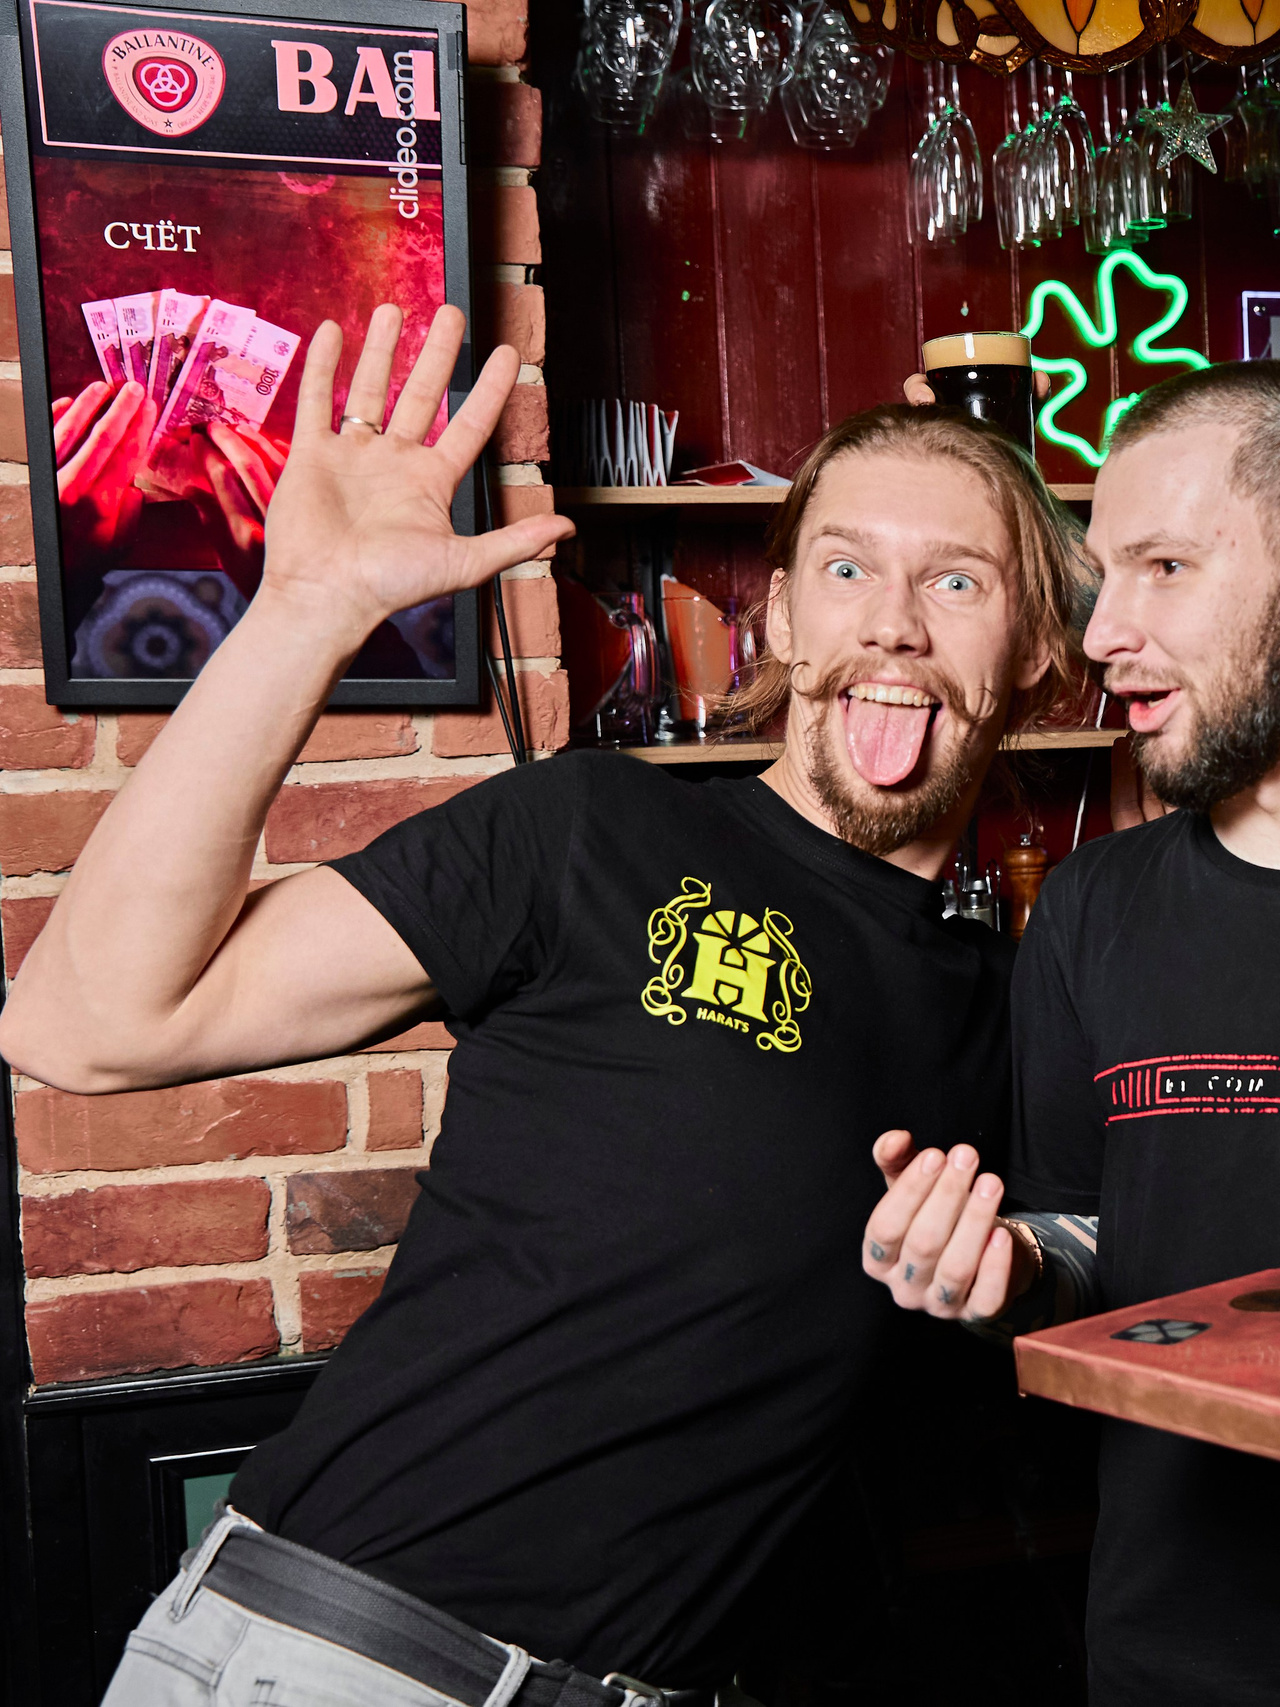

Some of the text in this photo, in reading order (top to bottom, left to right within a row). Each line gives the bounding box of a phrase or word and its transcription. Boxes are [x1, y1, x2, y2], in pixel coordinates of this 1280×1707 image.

[112, 34, 214, 67] BALLANTINE
[388, 51, 420, 219] clideo.com
[104, 220, 200, 252] СЧЁТ
[696, 1007, 750, 1033] HARAT'S
